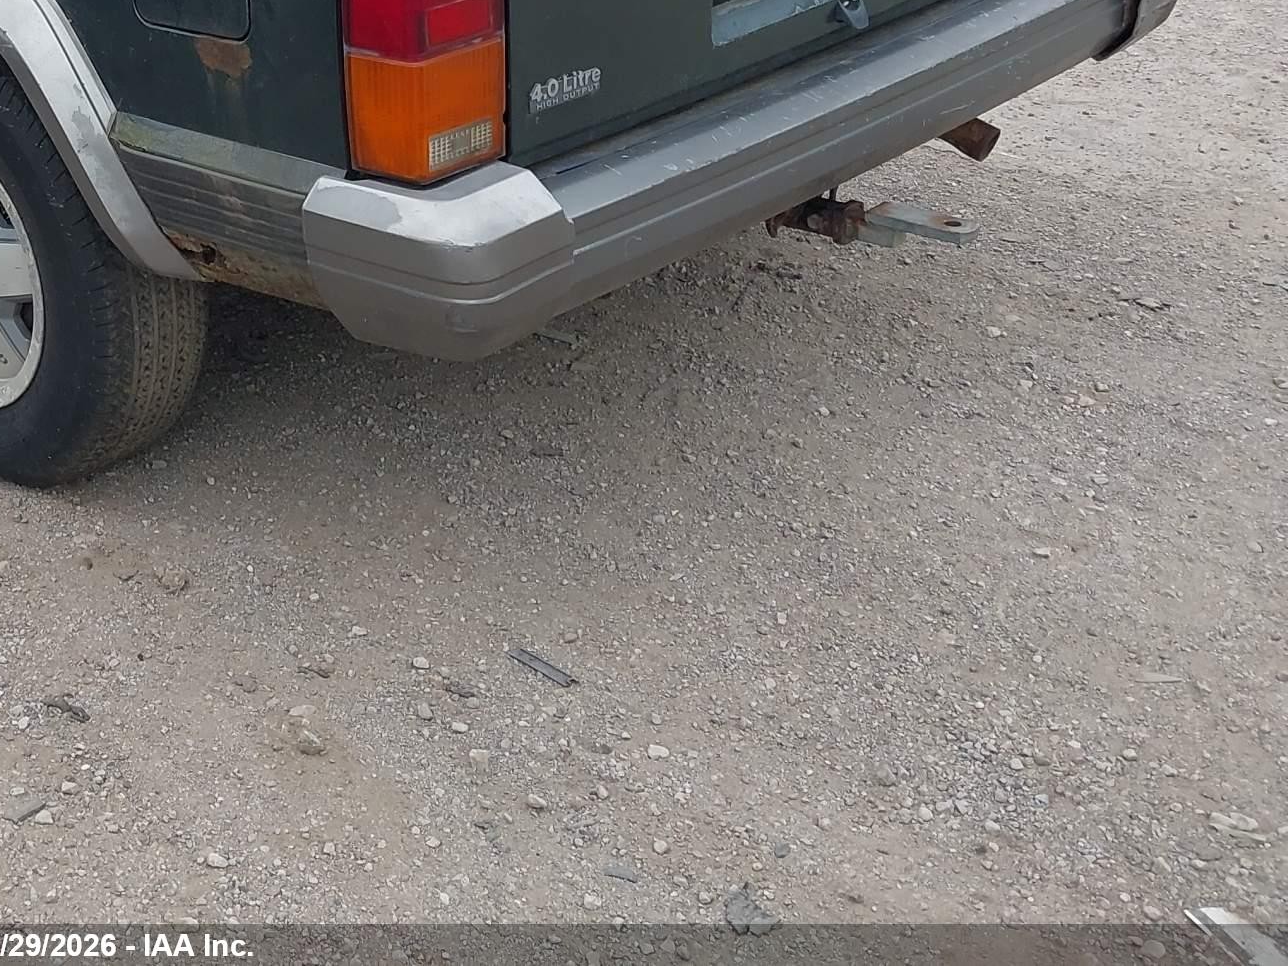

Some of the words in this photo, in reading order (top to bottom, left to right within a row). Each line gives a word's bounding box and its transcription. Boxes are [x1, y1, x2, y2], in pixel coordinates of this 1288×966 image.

[530, 78, 559, 102] 4.0
[563, 67, 601, 93] Litre
[536, 97, 559, 111] HIGH
[562, 81, 600, 101] OUTPUT
